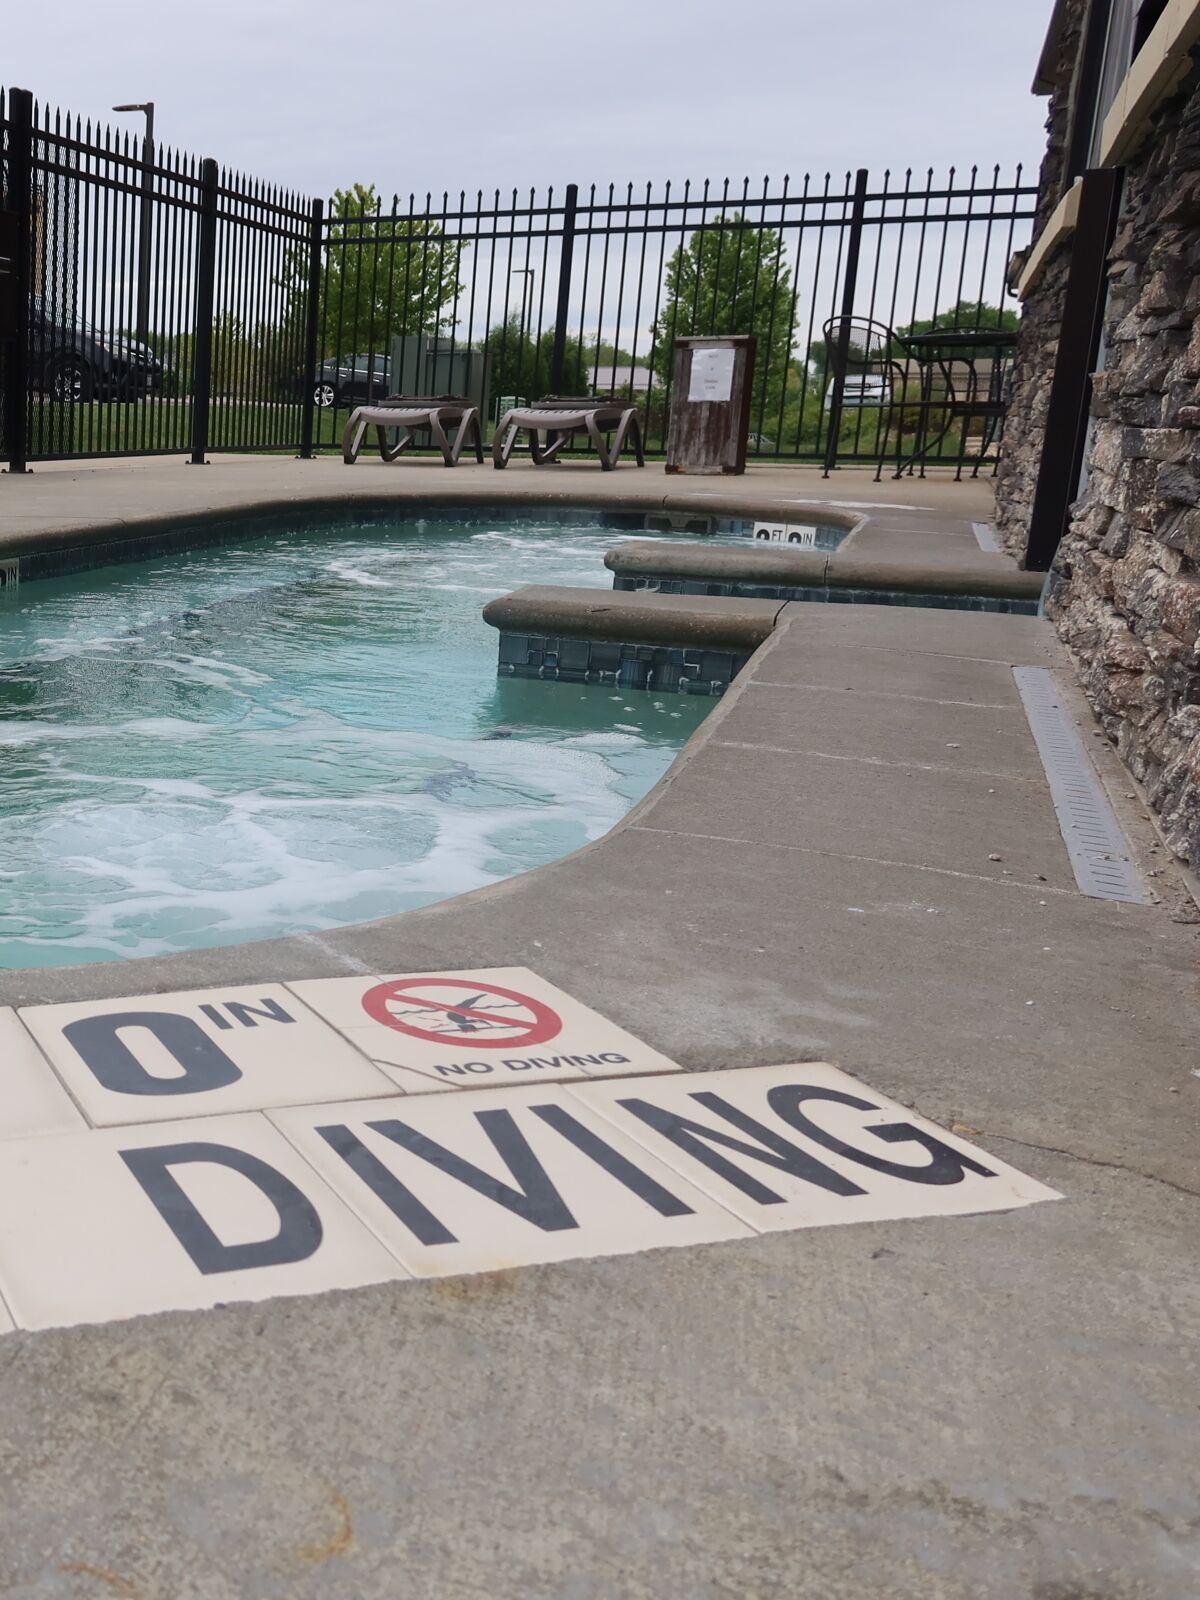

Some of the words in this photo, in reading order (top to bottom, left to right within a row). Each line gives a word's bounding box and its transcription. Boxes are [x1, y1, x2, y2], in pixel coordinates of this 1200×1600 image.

[8, 567, 17, 581] IN
[62, 1010, 244, 1096] 0
[198, 998, 298, 1030] IN
[433, 1061, 494, 1076] NO
[501, 1052, 631, 1071] DIVING
[117, 1084, 1000, 1275] DIVING
